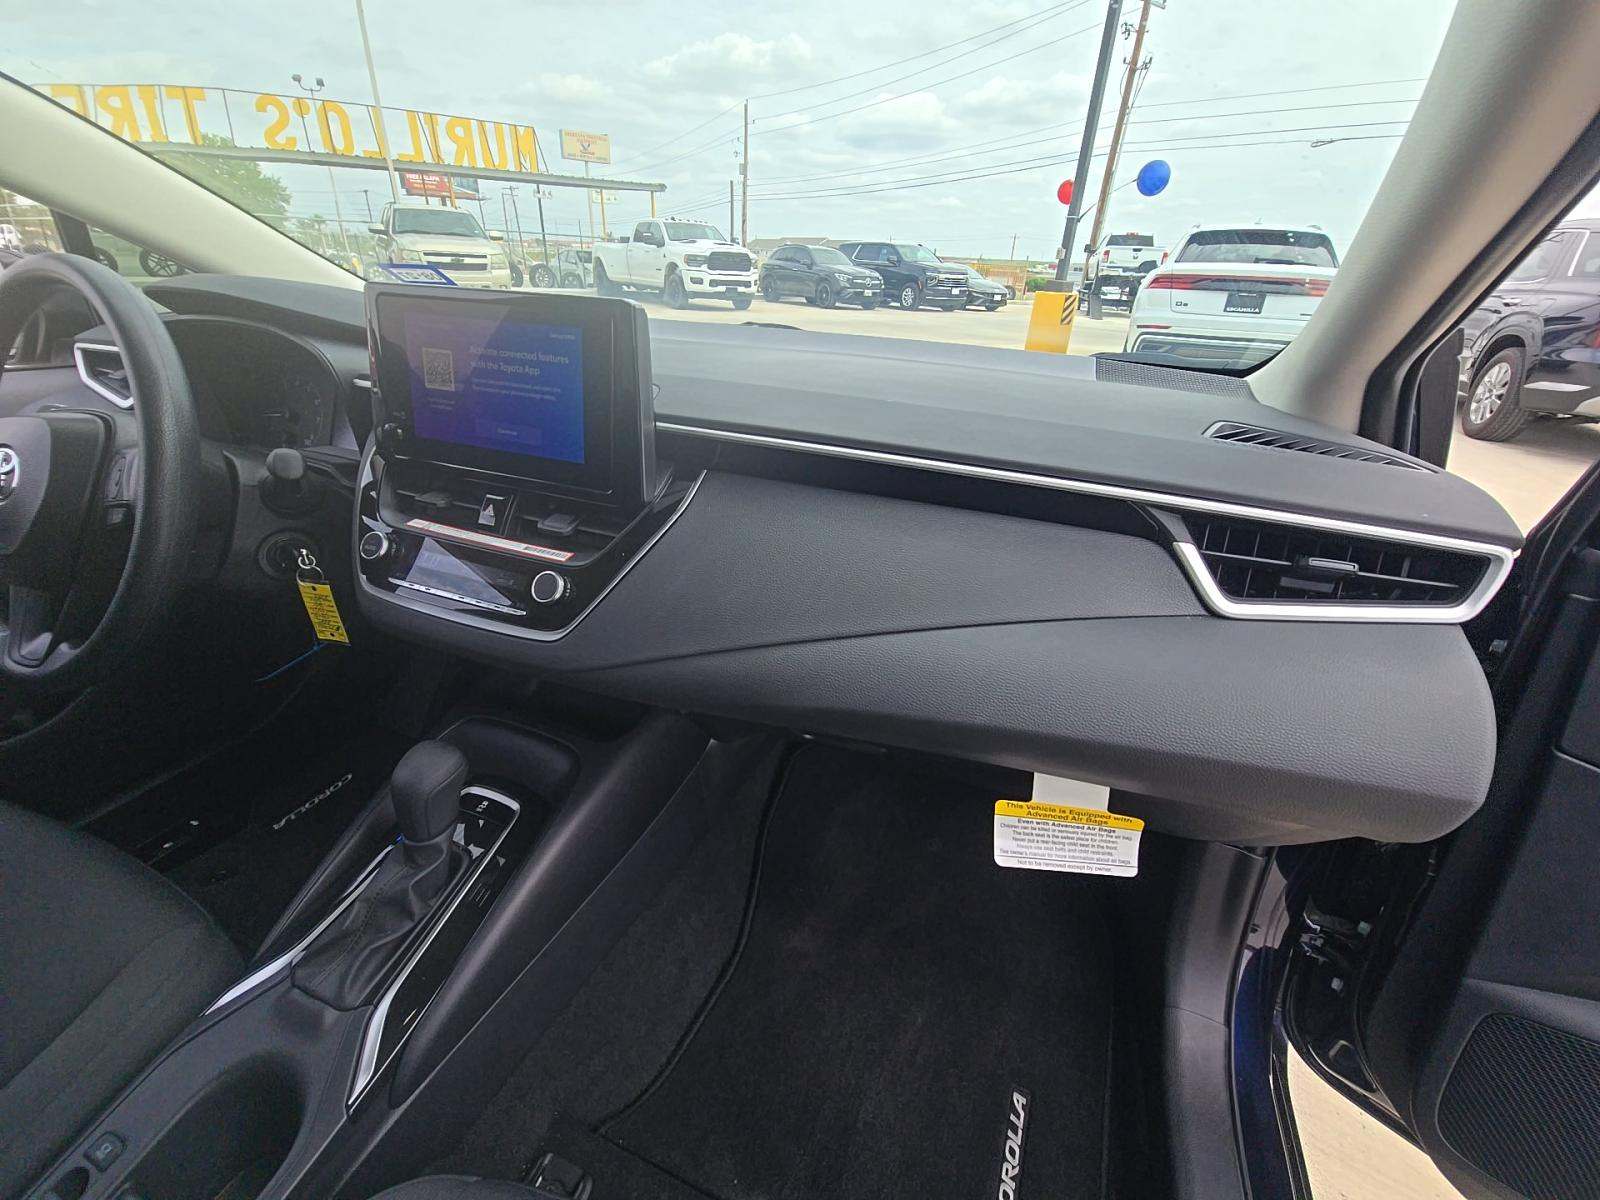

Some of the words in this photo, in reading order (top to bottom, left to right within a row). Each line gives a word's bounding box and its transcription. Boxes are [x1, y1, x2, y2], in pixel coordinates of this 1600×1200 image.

[1006, 801, 1023, 809] This
[1026, 804, 1056, 813] Vehicle
[1069, 809, 1111, 820] Equipped
[1025, 810, 1068, 820] Advanced
[1051, 822, 1084, 830] Advanced
